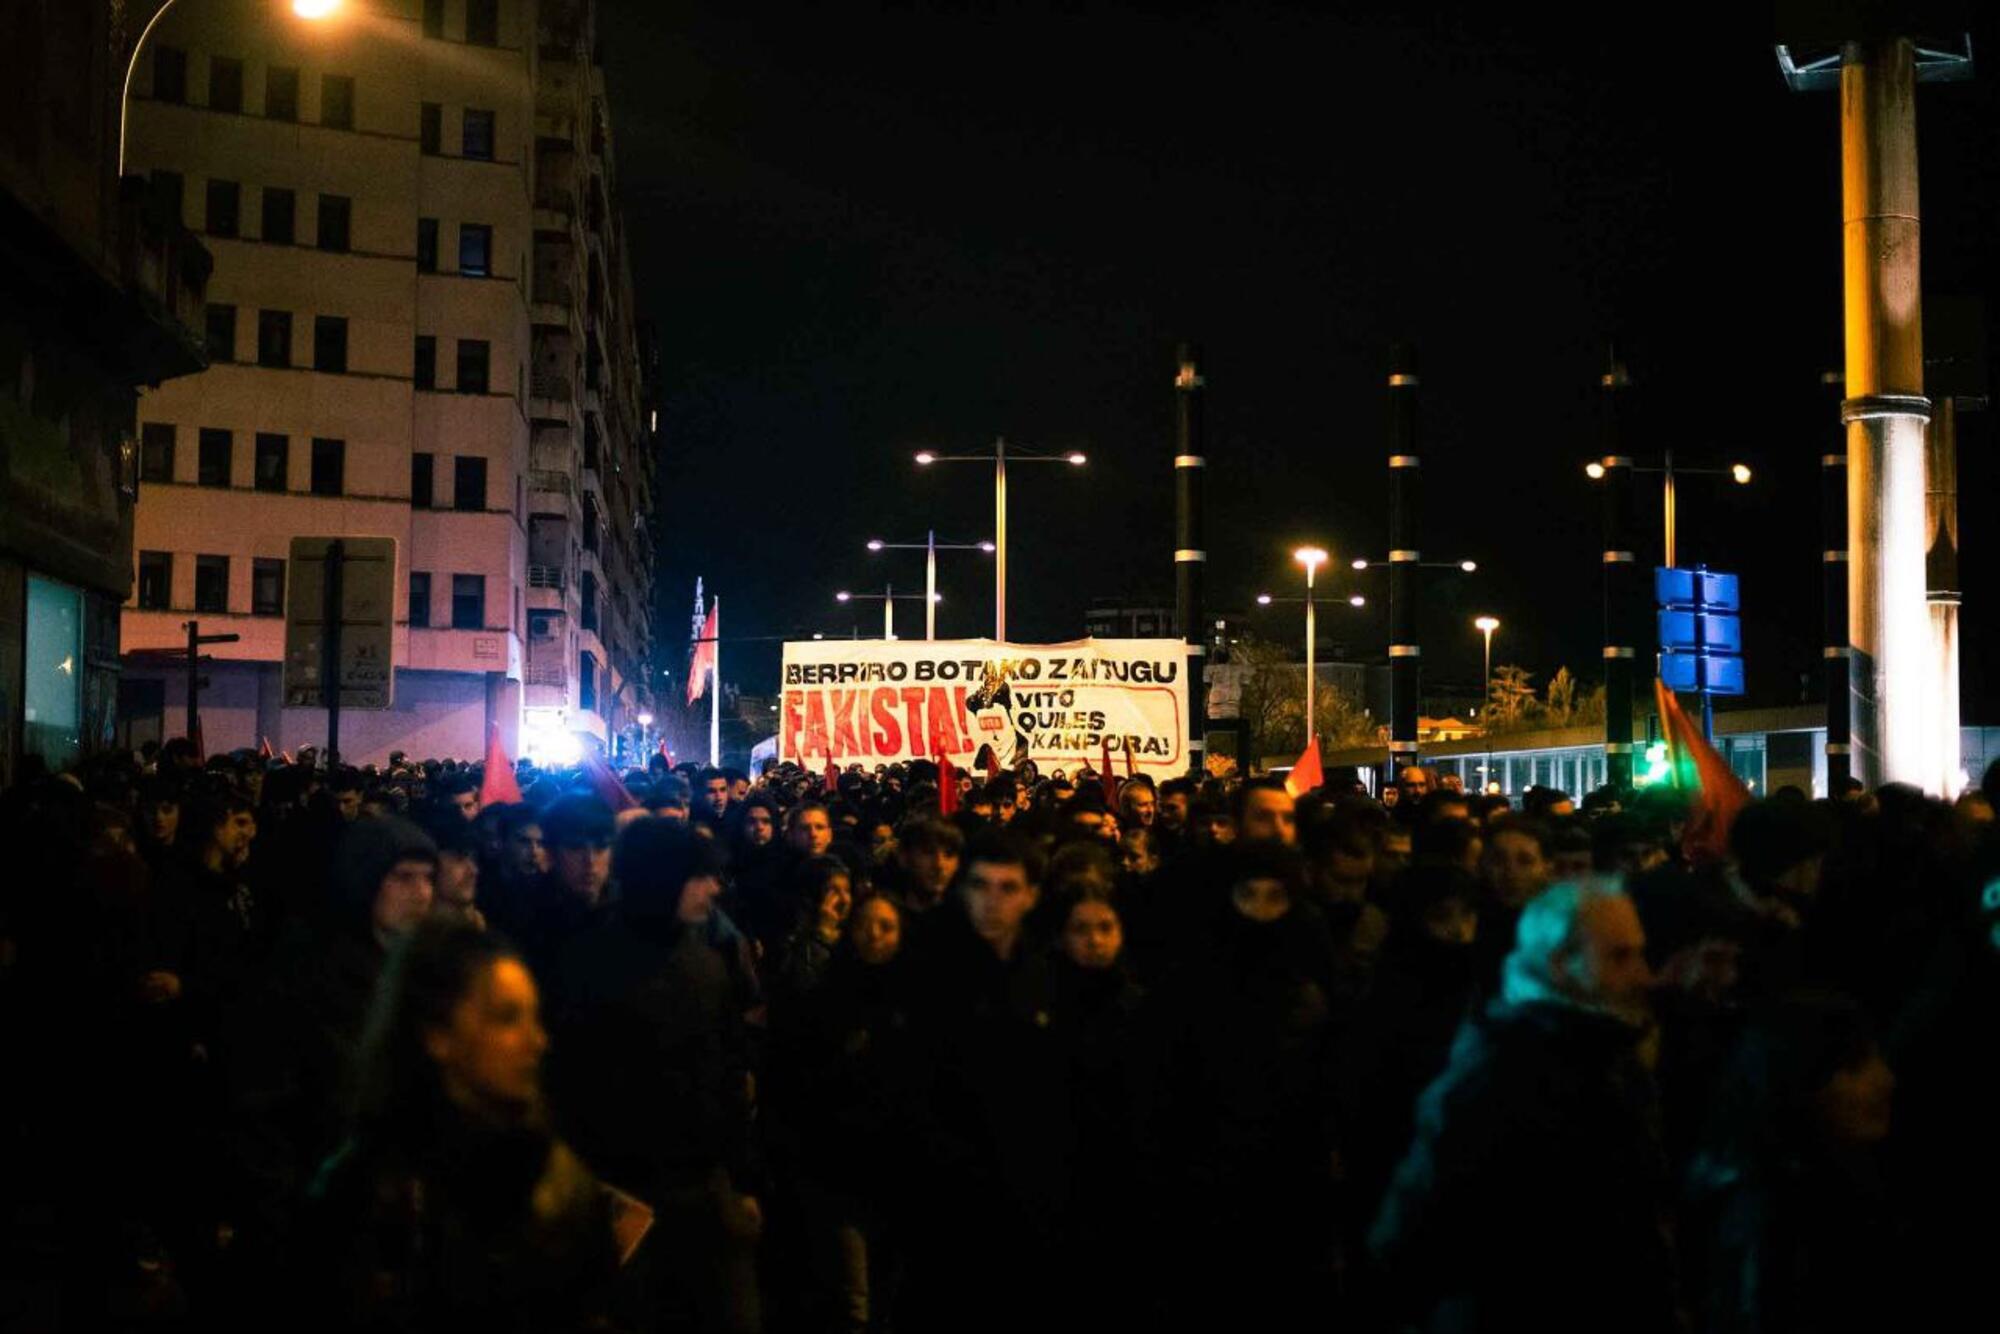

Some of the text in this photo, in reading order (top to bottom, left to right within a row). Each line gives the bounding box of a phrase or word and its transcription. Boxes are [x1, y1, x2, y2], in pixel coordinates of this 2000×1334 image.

[785, 658, 1177, 684] BERRIRO BOTAKO ZAITUGU
[1015, 690, 1075, 708] VITO
[784, 686, 975, 758] FAKISTA!
[1017, 711, 1106, 733] QUILES
[1031, 733, 1170, 756] KANPORA!
